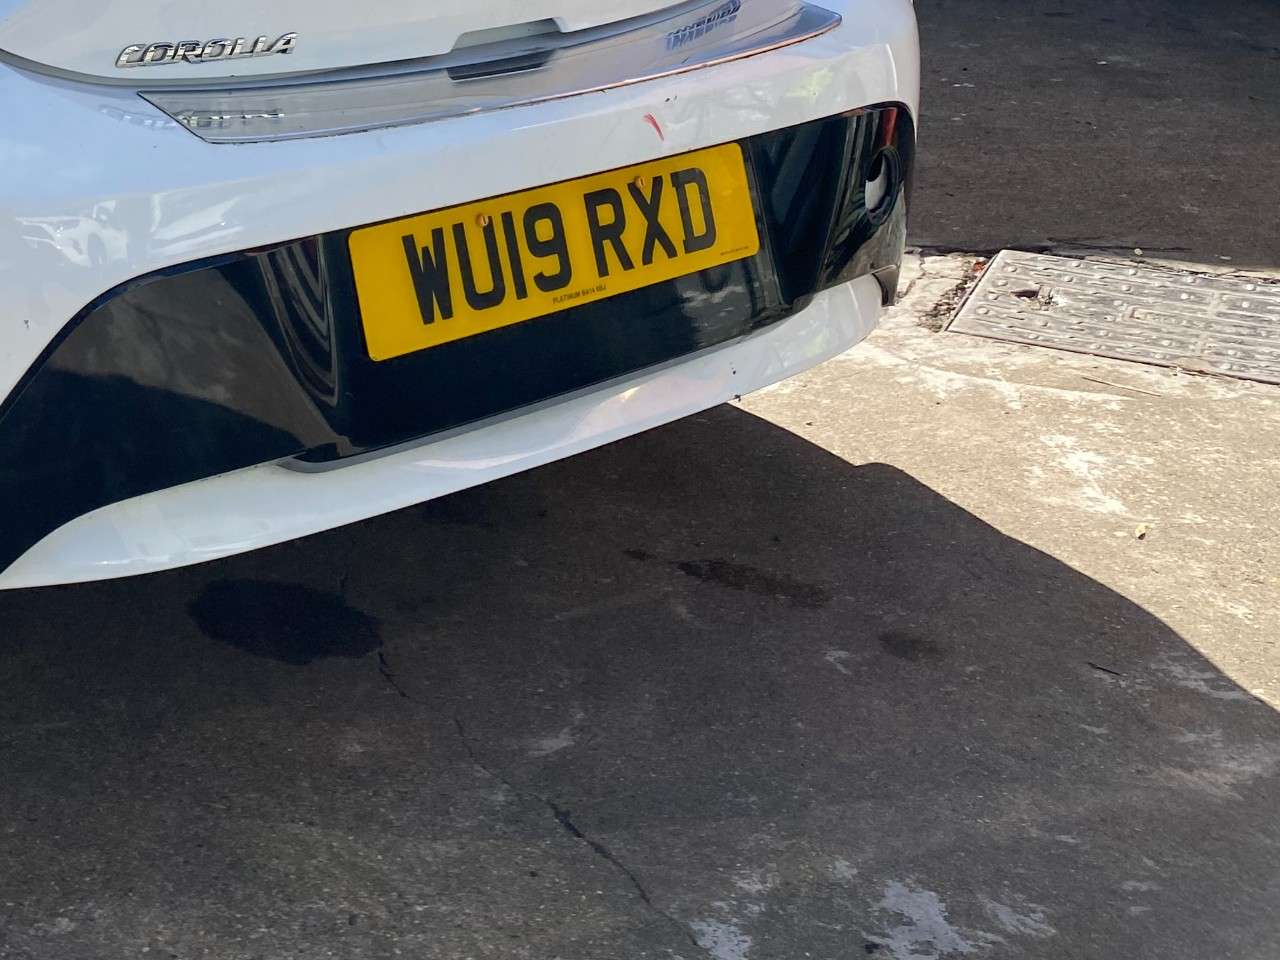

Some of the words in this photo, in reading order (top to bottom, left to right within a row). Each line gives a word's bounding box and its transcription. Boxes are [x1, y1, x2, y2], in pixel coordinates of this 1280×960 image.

[115, 32, 298, 68] COROLLA
[402, 202, 573, 326] WU19
[583, 167, 717, 279] RXD
